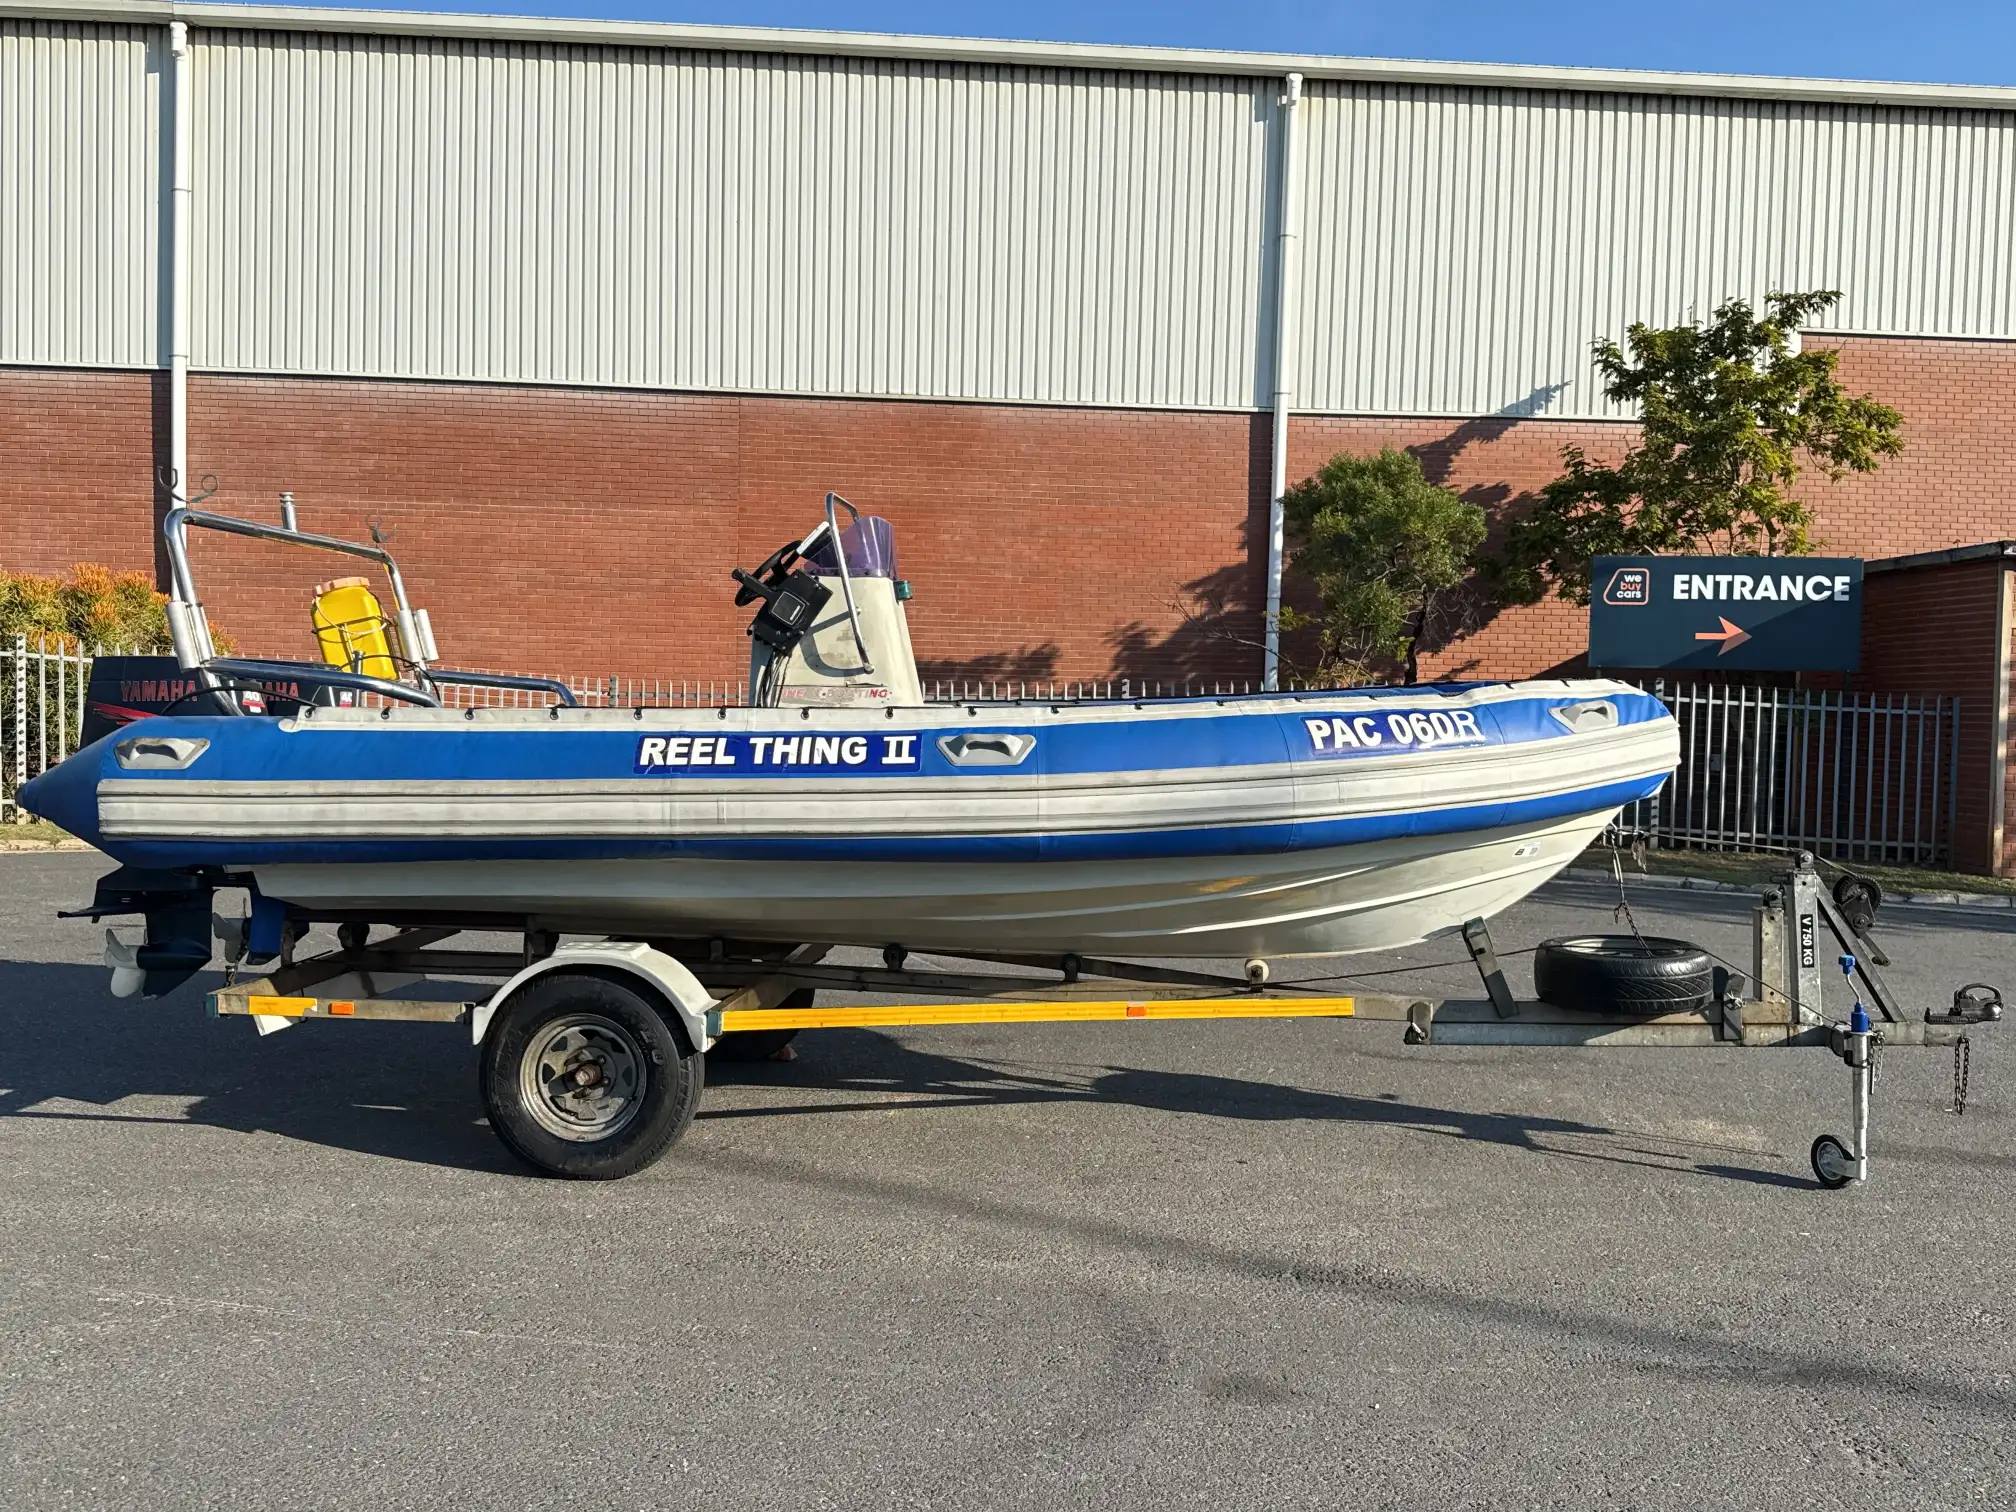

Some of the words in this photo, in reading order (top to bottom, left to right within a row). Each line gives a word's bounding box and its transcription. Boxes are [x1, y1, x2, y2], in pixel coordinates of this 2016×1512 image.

[1620, 581, 1642, 591] buy
[1624, 574, 1642, 583] we
[1616, 590, 1642, 599] cars
[1673, 574, 1850, 601] ENTRANCE
[121, 680, 197, 702] YAMAHA
[245, 690, 260, 701] 40
[1305, 717, 1382, 750] PAC
[1387, 710, 1486, 745] 060R
[640, 738, 735, 765] REEL
[749, 737, 868, 765] THING
[881, 735, 917, 764] II
[1802, 917, 1812, 925] V
[1802, 927, 1813, 946] 750
[1803, 949, 1813, 965] KG
